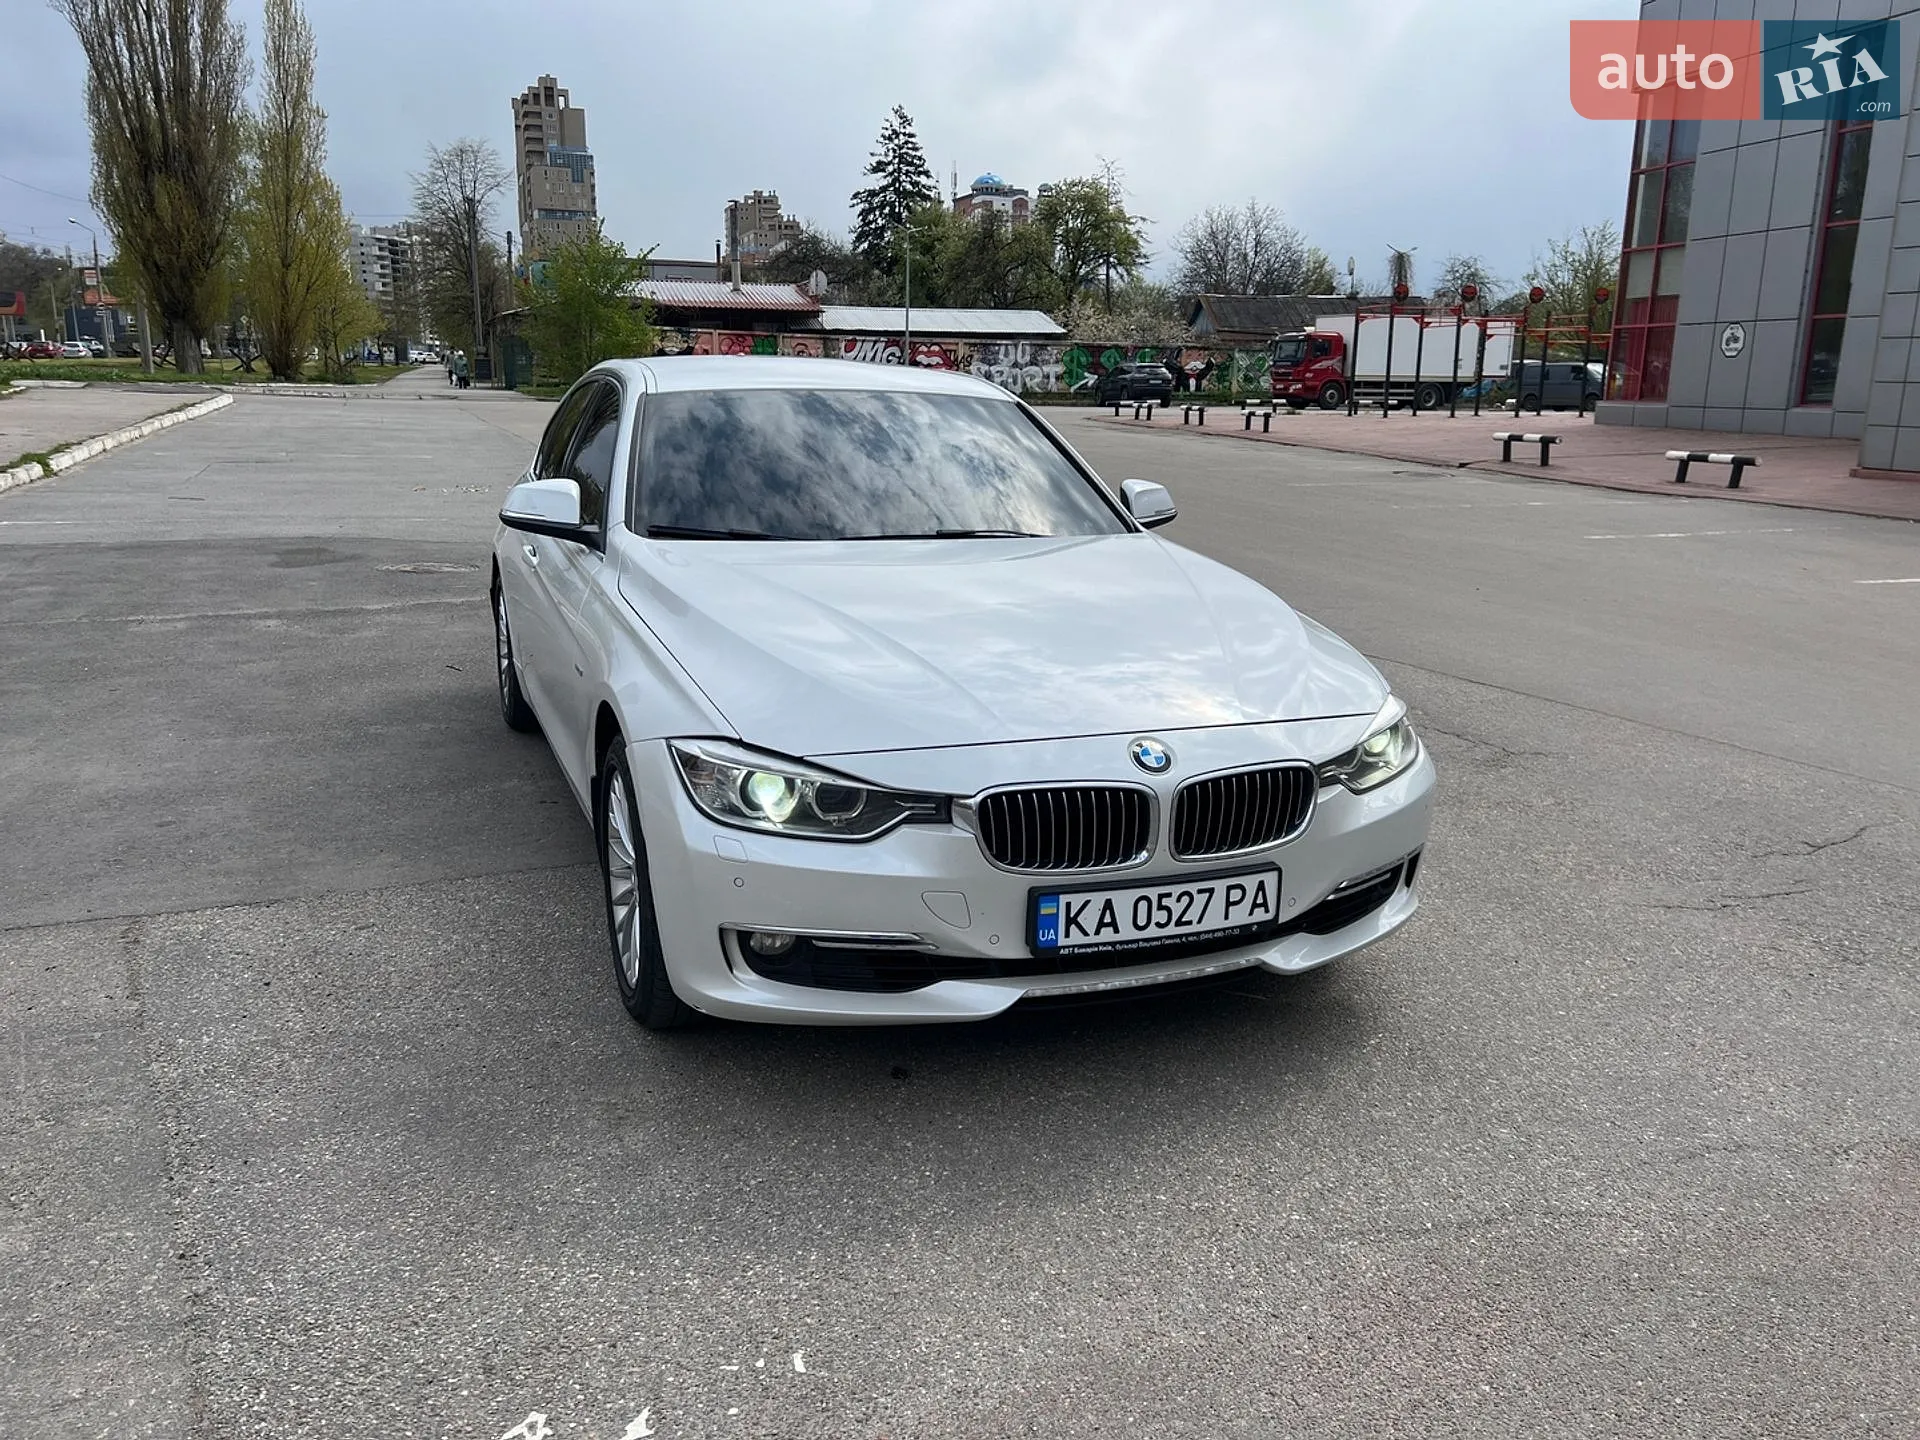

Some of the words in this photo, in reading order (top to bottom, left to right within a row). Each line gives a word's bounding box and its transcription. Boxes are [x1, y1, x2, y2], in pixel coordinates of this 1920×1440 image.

[1064, 898, 1120, 939] KA
[1132, 886, 1215, 931] 0527
[1224, 879, 1270, 920] PA
[1039, 928, 1056, 941] UA
